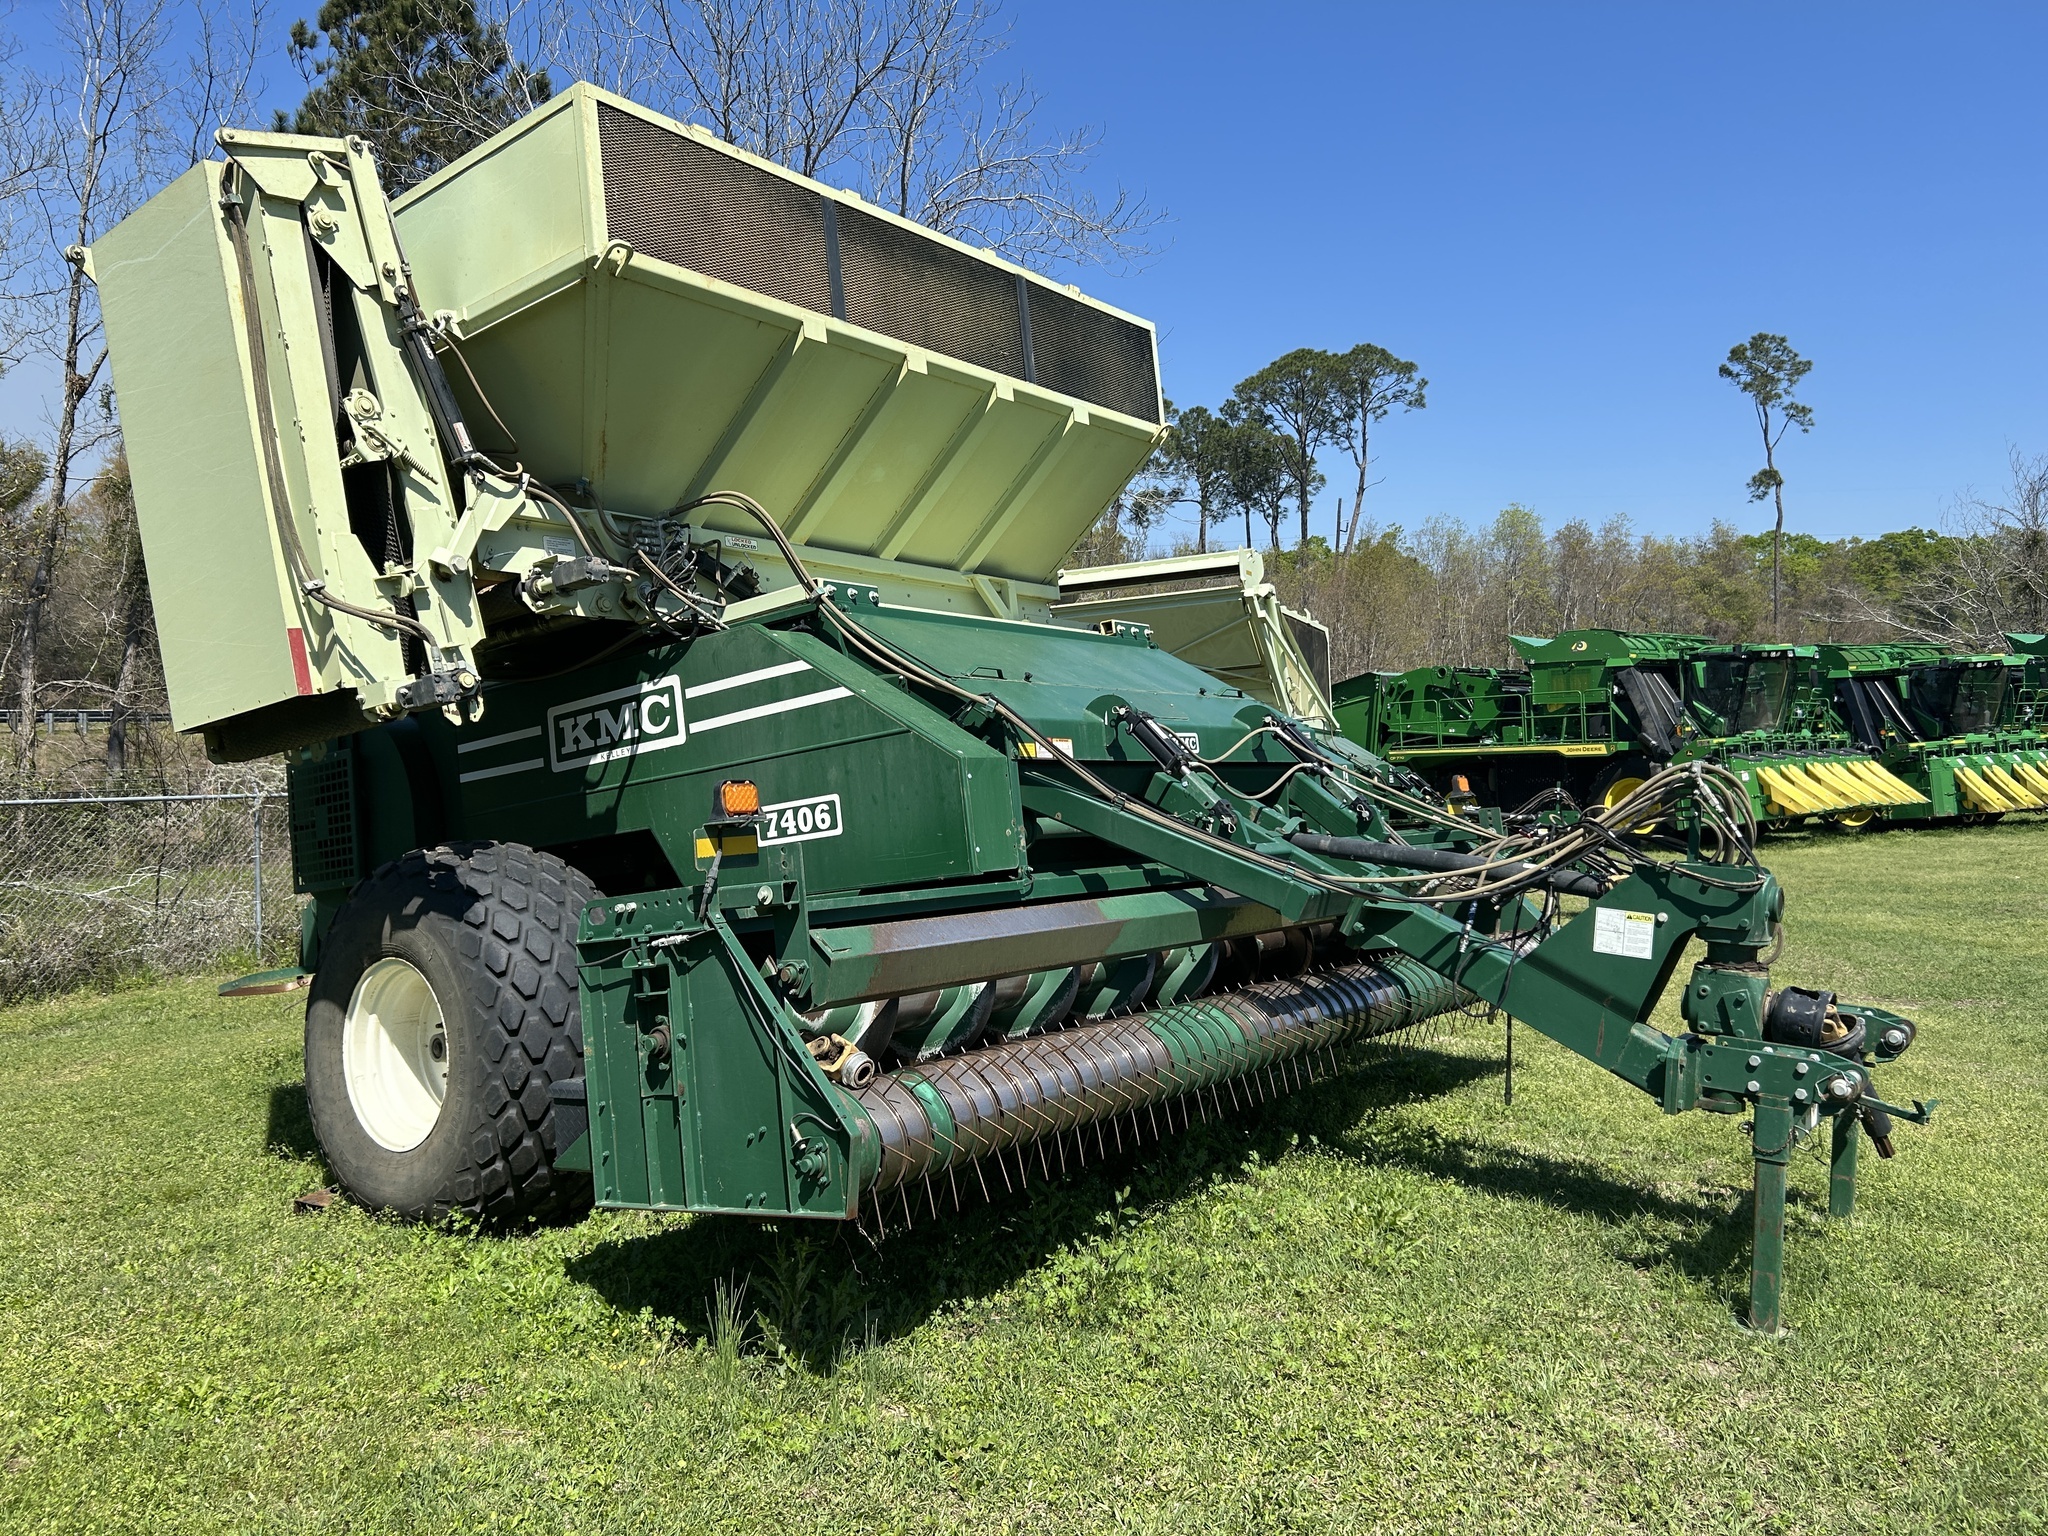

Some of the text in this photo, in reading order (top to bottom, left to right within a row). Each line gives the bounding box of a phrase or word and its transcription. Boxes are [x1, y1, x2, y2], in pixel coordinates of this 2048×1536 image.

[559, 693, 671, 755] KMC
[600, 748, 630, 760] KELLEY
[763, 803, 832, 839] 7406
[1632, 914, 1653, 922] CAUTION
